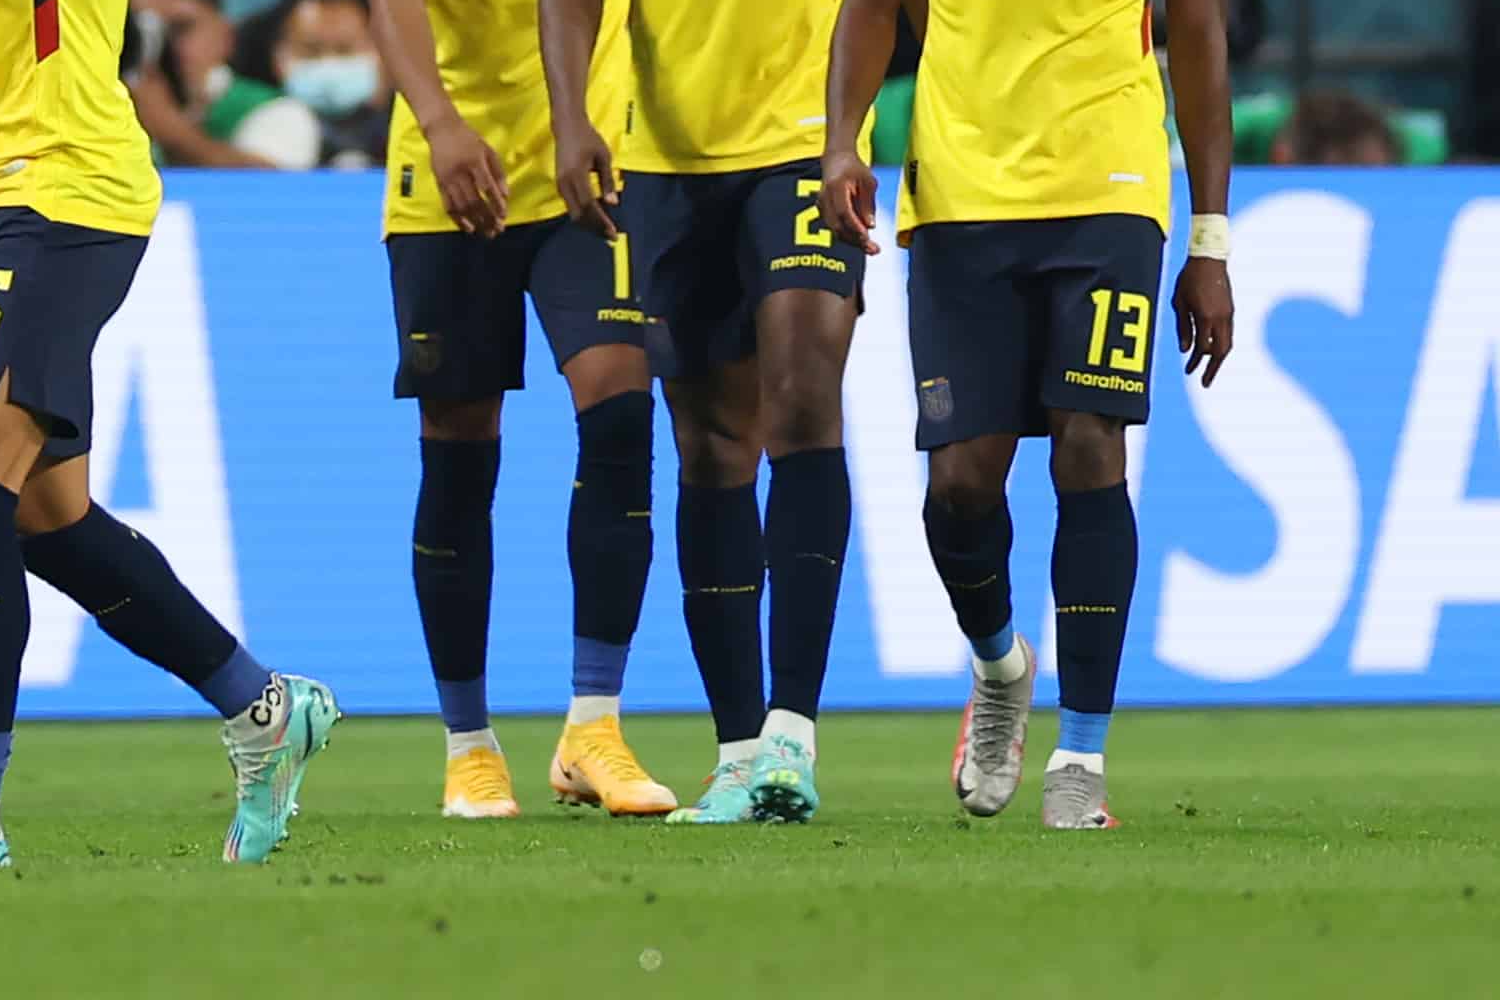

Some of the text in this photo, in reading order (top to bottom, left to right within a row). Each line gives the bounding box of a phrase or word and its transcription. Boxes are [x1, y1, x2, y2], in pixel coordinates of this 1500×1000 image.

[794, 179, 833, 247] 2
[769, 254, 847, 273] marathon
[597, 308, 646, 324] mara
[1088, 288, 1151, 374] 13
[1065, 370, 1145, 394] marathon
